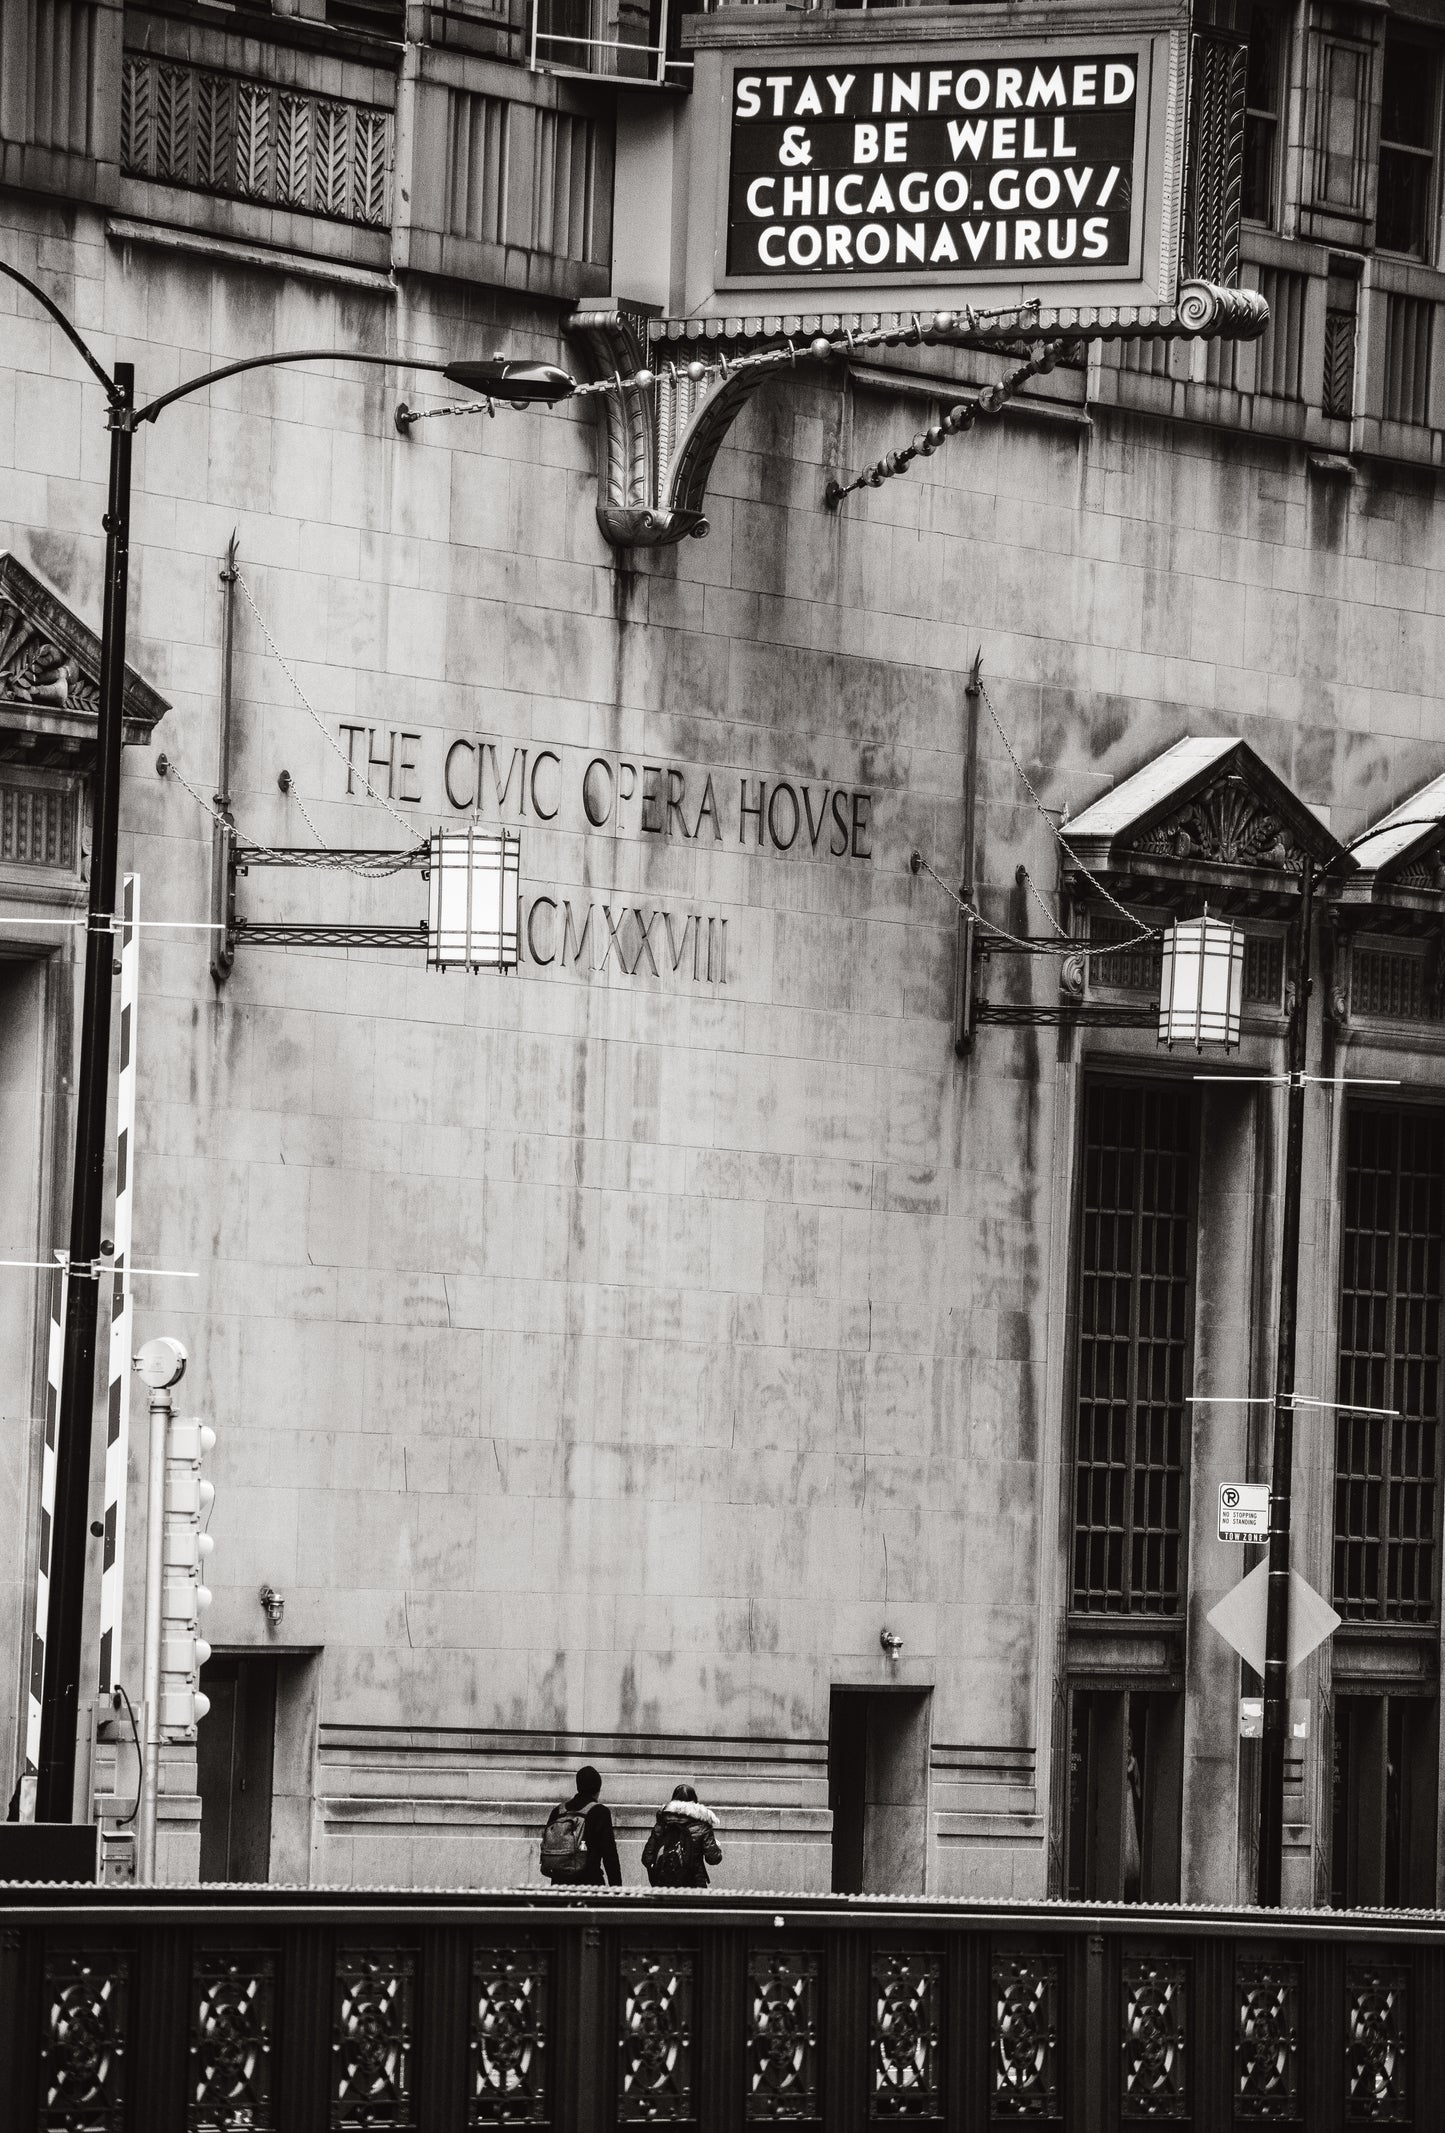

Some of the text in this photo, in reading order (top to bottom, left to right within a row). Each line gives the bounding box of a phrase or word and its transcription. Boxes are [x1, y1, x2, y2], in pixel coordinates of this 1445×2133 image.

[736, 63, 1136, 118] STAY INFORMED
[778, 116, 1077, 167] & BE WELL
[746, 166, 1121, 218] CHICAGO.GOV/
[757, 217, 1109, 267] CORONAVIRUS
[339, 724, 872, 860] THE CIVIC OPERA HOVSE
[518, 894, 729, 985] CMXXVIII
[1225, 1532, 1263, 1542] TOW ZONE
